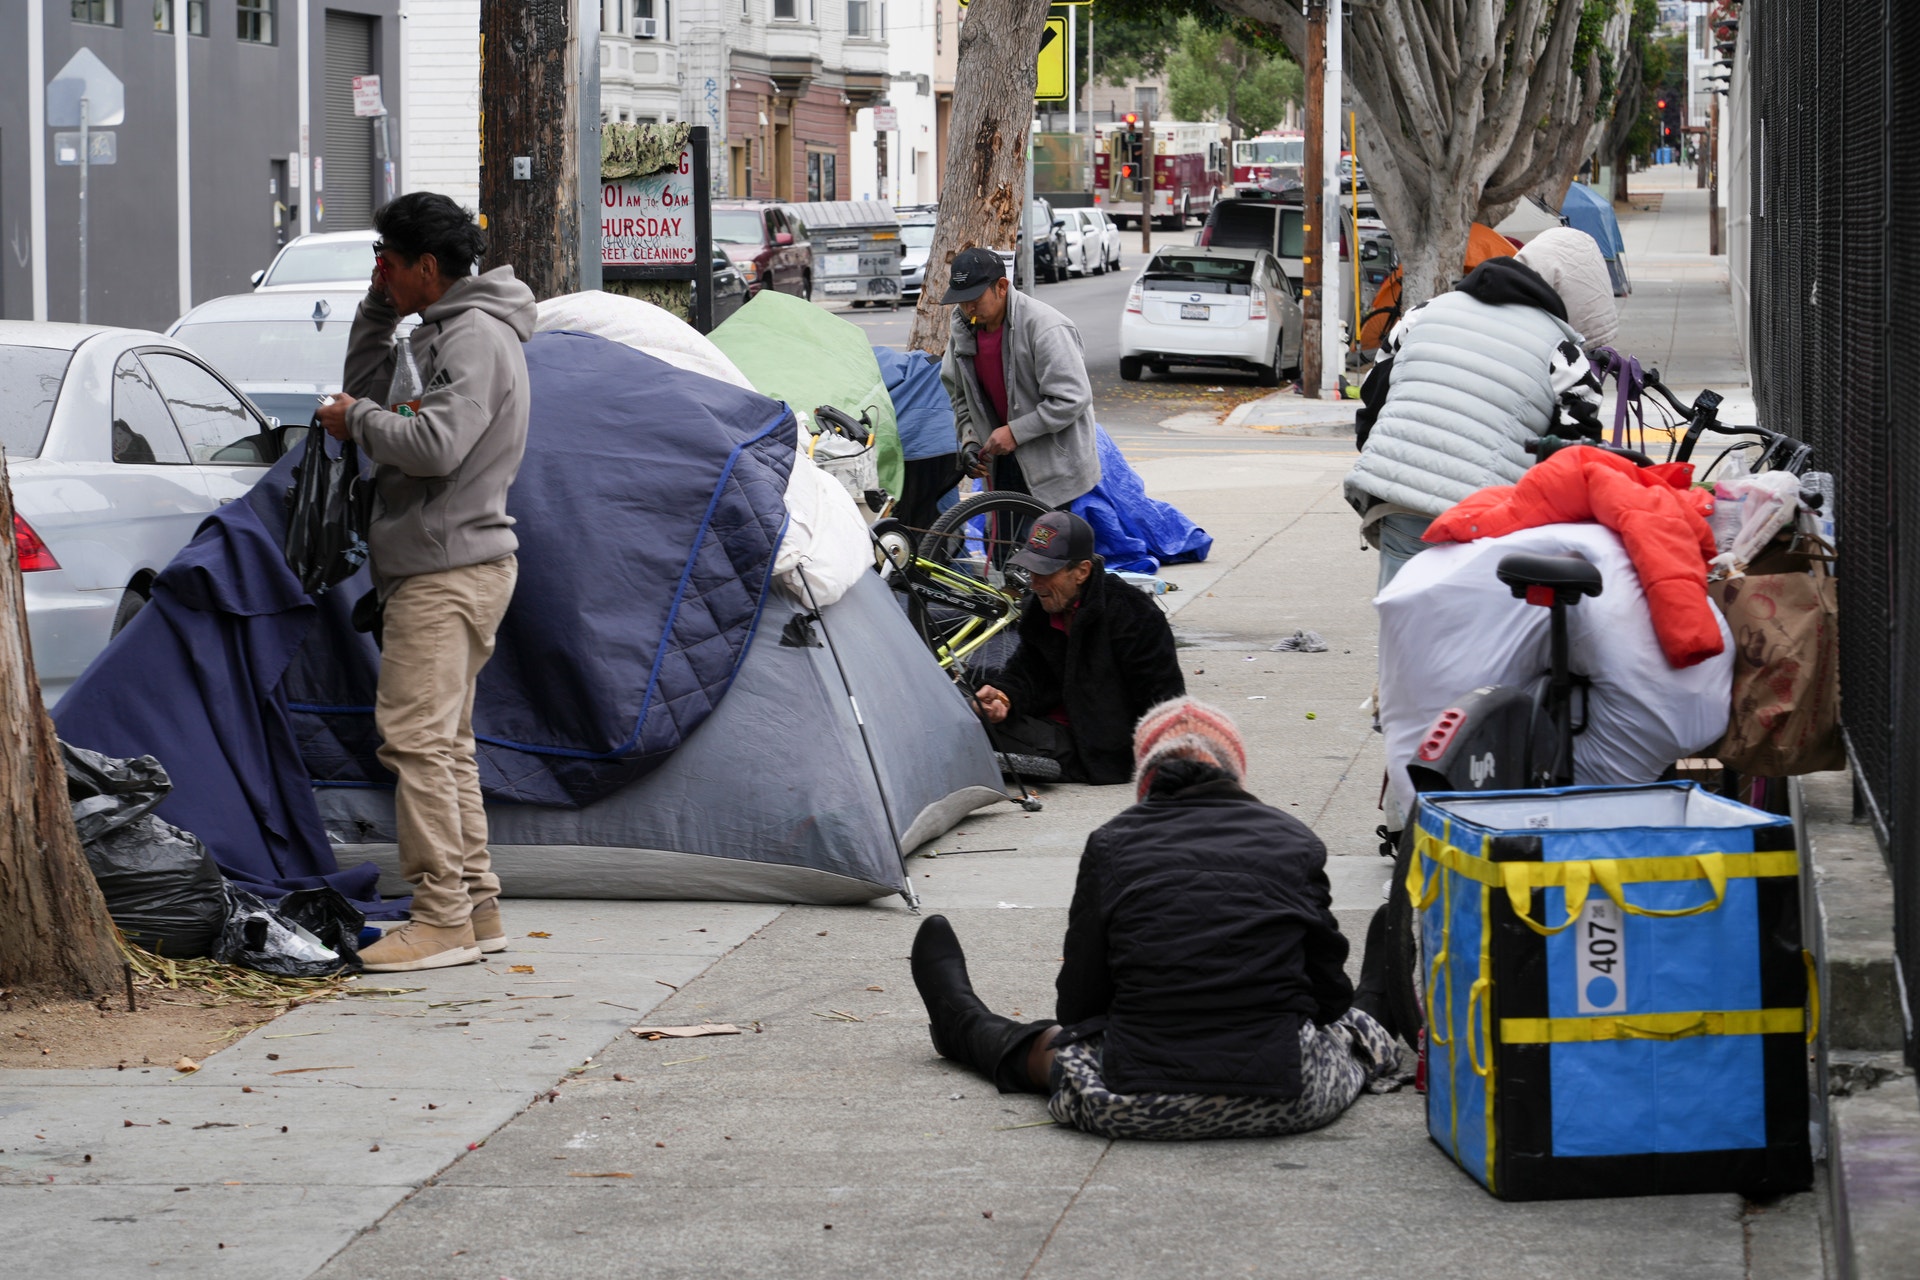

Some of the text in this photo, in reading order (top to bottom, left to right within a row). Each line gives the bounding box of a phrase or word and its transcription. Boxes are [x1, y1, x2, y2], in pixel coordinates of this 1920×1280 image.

[600, 184, 622, 207] :01
[626, 195, 641, 207] AM
[601, 217, 682, 237] HURSDAY
[601, 247, 687, 260] REET CLEANING
[1470, 752, 1495, 788] lyft
[1588, 921, 1617, 974] 407
